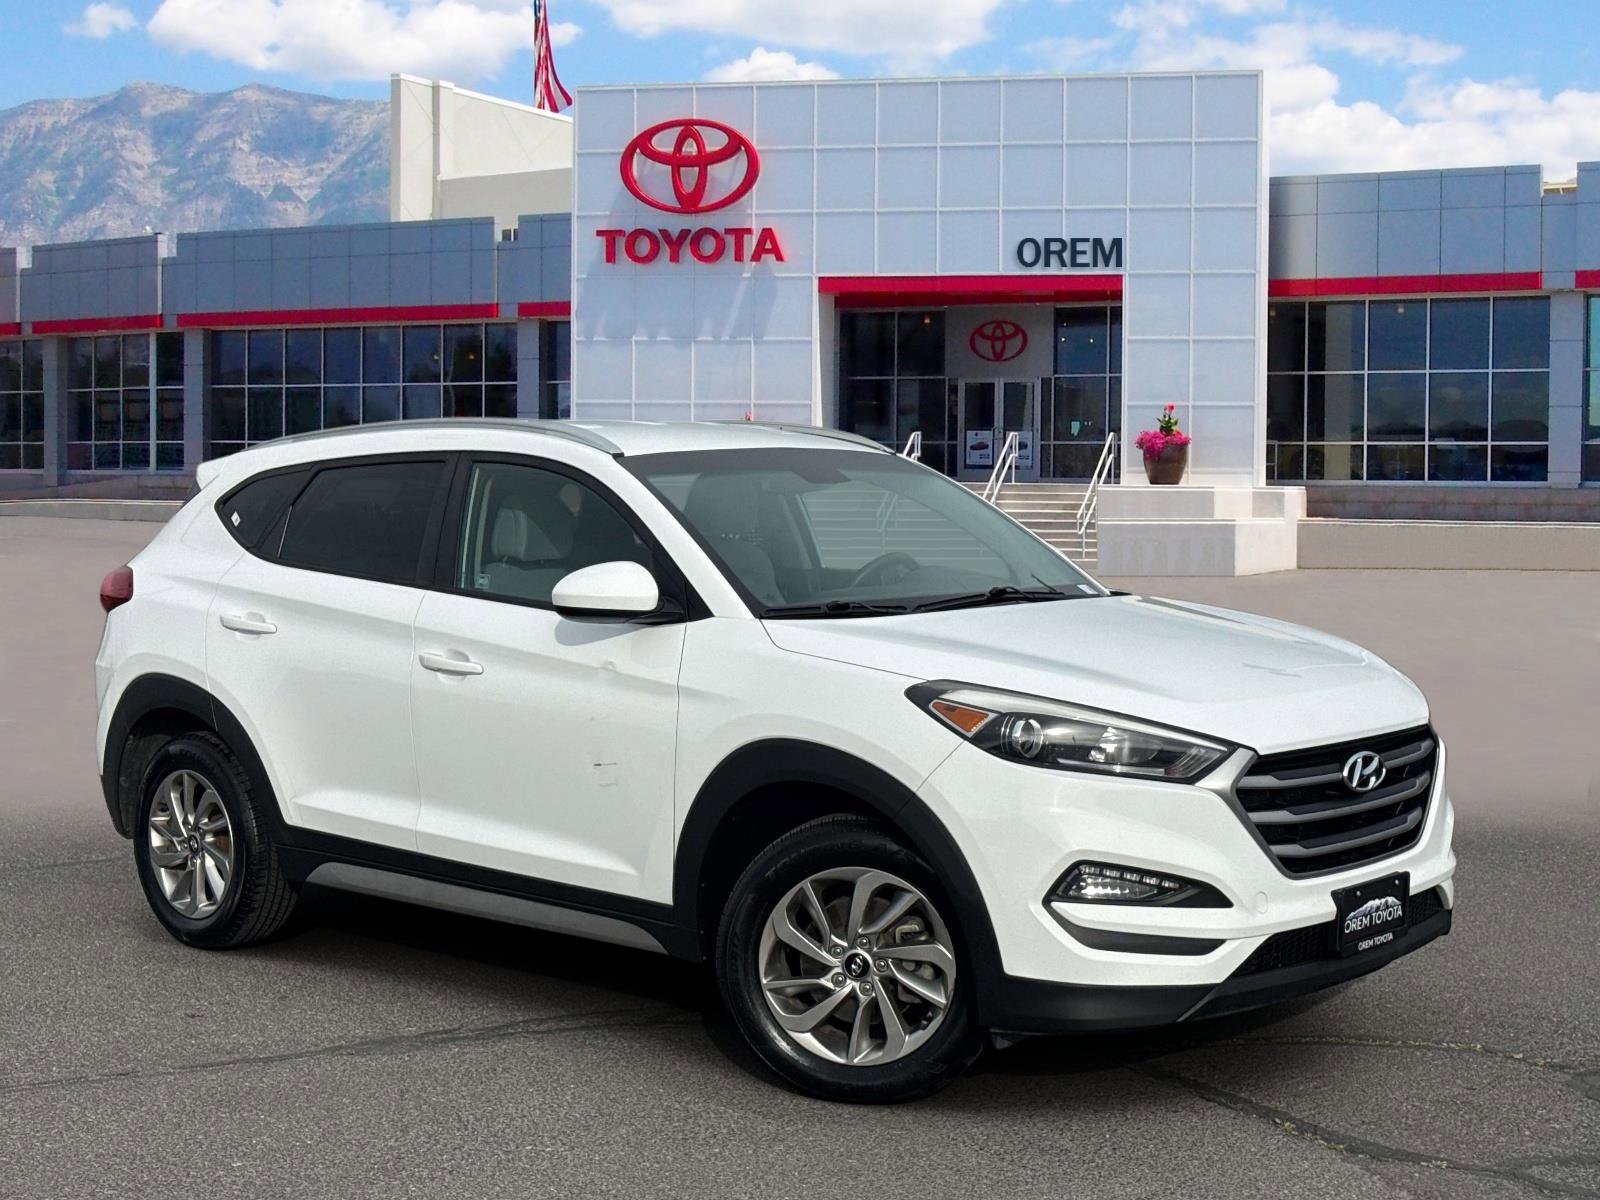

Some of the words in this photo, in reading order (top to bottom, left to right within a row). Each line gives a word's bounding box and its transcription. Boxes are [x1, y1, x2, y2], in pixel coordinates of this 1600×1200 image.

[597, 228, 785, 264] TOYOTA
[1017, 237, 1122, 269] OREM
[1344, 914, 1370, 933] OREM
[1372, 905, 1403, 925] TOYOTA
[1358, 939, 1374, 951] OREM
[1374, 932, 1393, 945] TOYOTA
